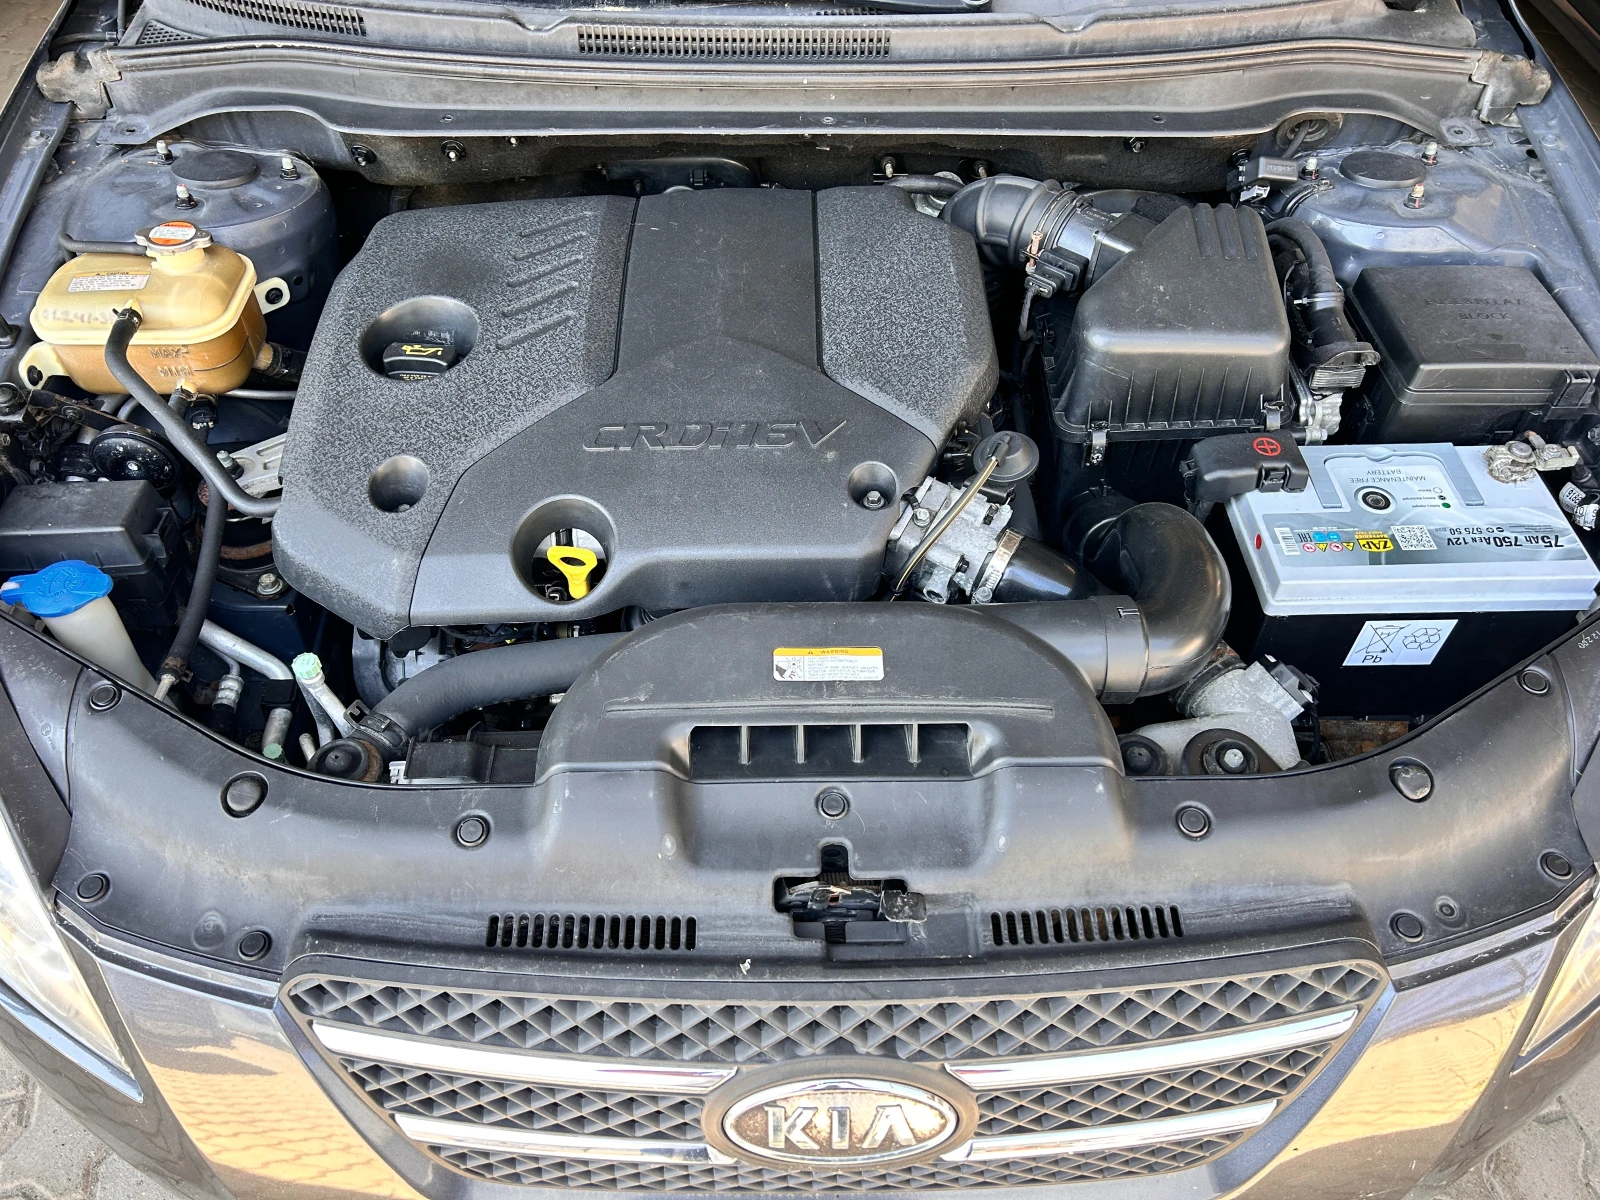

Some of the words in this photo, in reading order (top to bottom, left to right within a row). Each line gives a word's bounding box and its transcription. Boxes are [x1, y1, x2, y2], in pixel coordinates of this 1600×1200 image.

[1459, 312, 1512, 321] BLOCK
[148, 347, 180, 358] MAX
[157, 365, 191, 377] MIN
[1366, 468, 1402, 476] BATTERY
[1372, 475, 1426, 484] MAINTENANCE
[1449, 527, 1462, 535] 50
[1464, 527, 1483, 535] 575
[1362, 540, 1392, 550] ZAP
[1446, 536, 1469, 546] 12V
[1361, 654, 1382, 664] Pb
[763, 1104, 917, 1150] KIA
